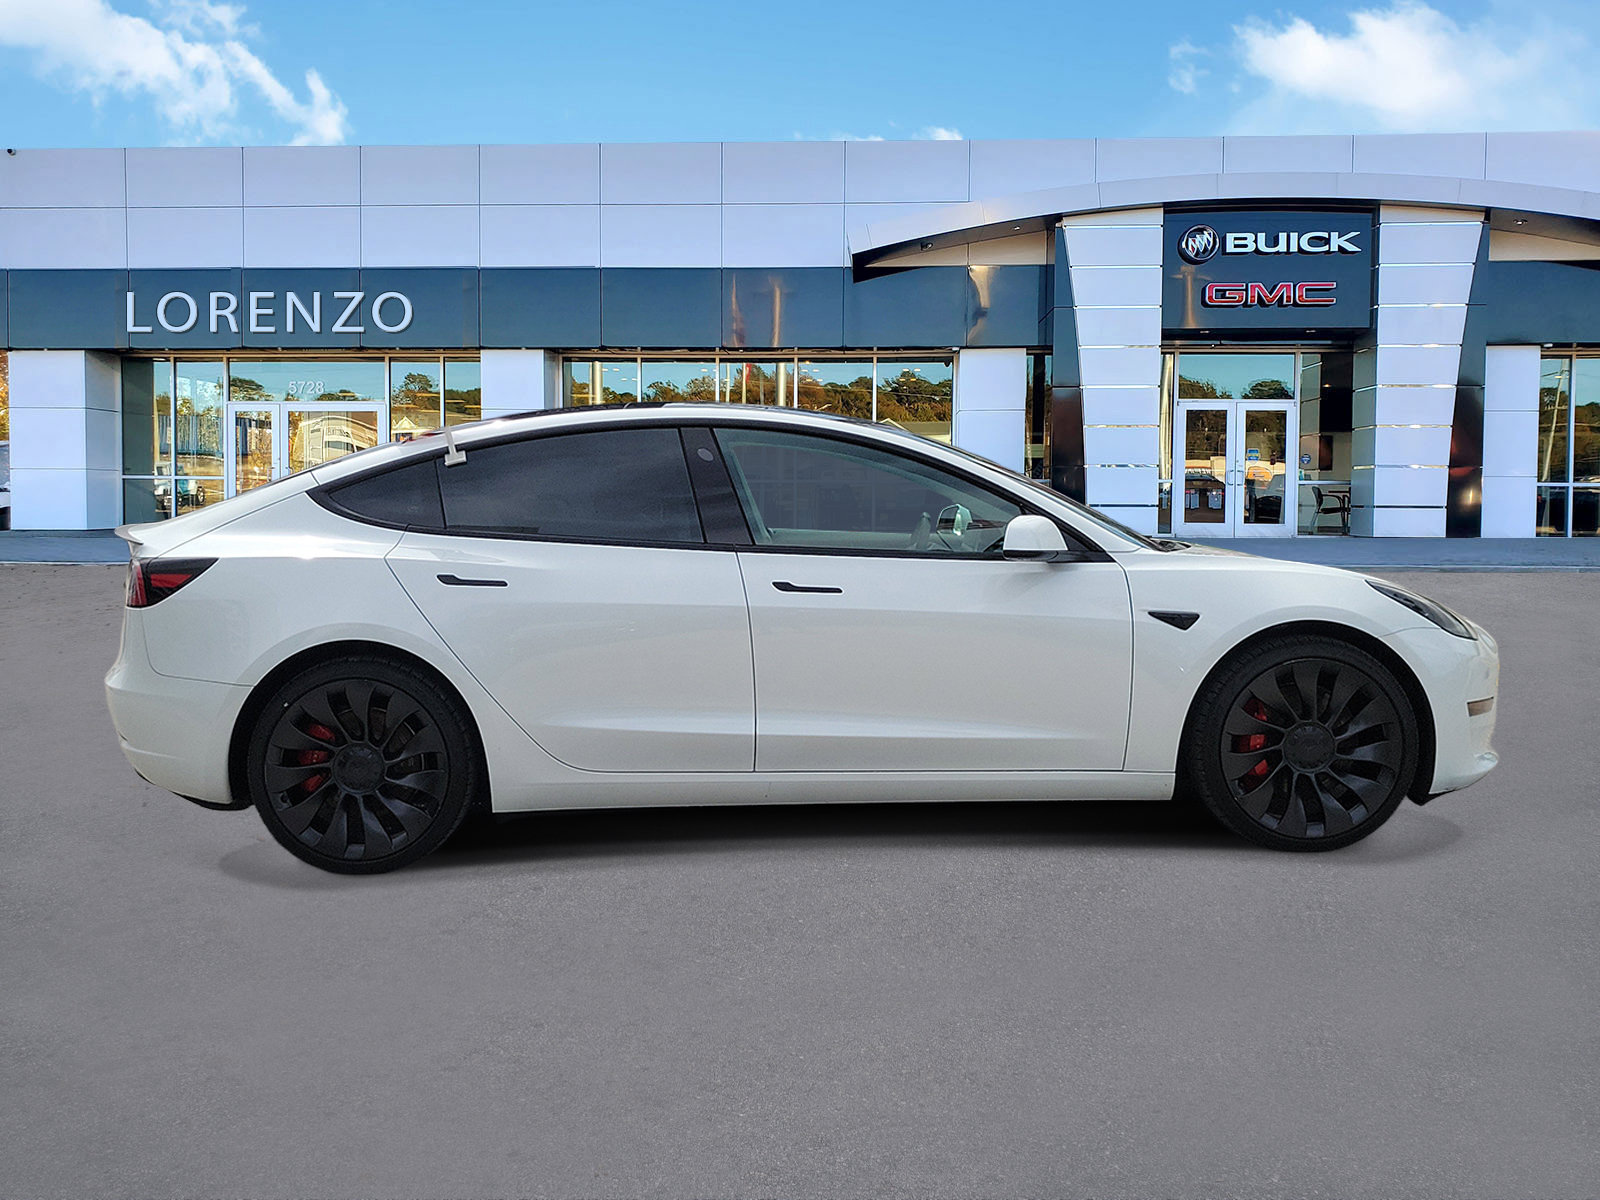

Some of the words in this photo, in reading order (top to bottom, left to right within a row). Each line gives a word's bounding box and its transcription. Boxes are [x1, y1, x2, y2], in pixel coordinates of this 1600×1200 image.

[1225, 231, 1362, 253] BUICK
[1205, 281, 1337, 305] GMC
[126, 291, 414, 333] LORENZO
[288, 380, 325, 394] 5728
